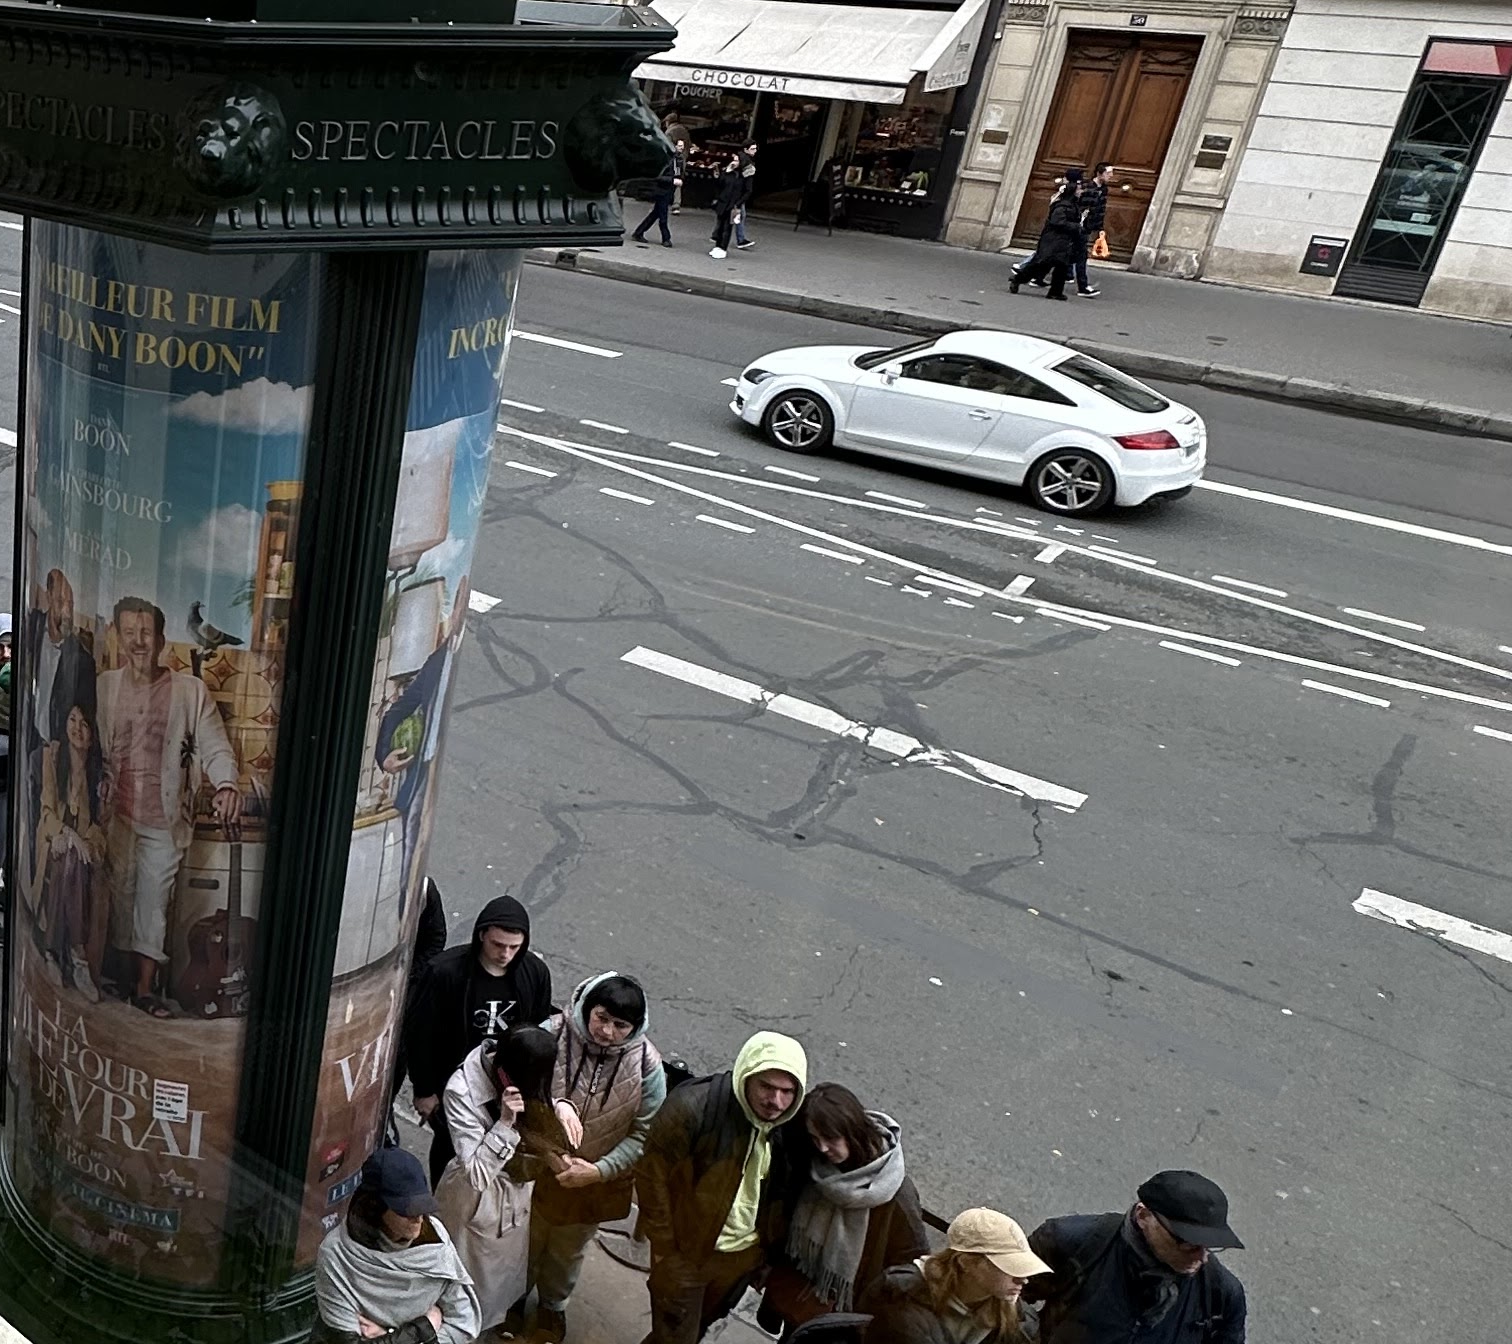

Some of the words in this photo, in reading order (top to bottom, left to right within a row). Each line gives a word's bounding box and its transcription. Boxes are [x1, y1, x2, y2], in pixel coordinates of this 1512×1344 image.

[673, 83, 723, 104] FOUCHER
[691, 69, 790, 92] CHOCOLAT
[291, 120, 559, 160] SPECTACLES
[186, 291, 283, 333] FILM
[57, 309, 128, 360] DANY
[74, 418, 131, 456] BOON
[61, 1029, 152, 1101] POUR
[60, 1063, 210, 1160] VRAI
[66, 1144, 127, 1188] BOON
